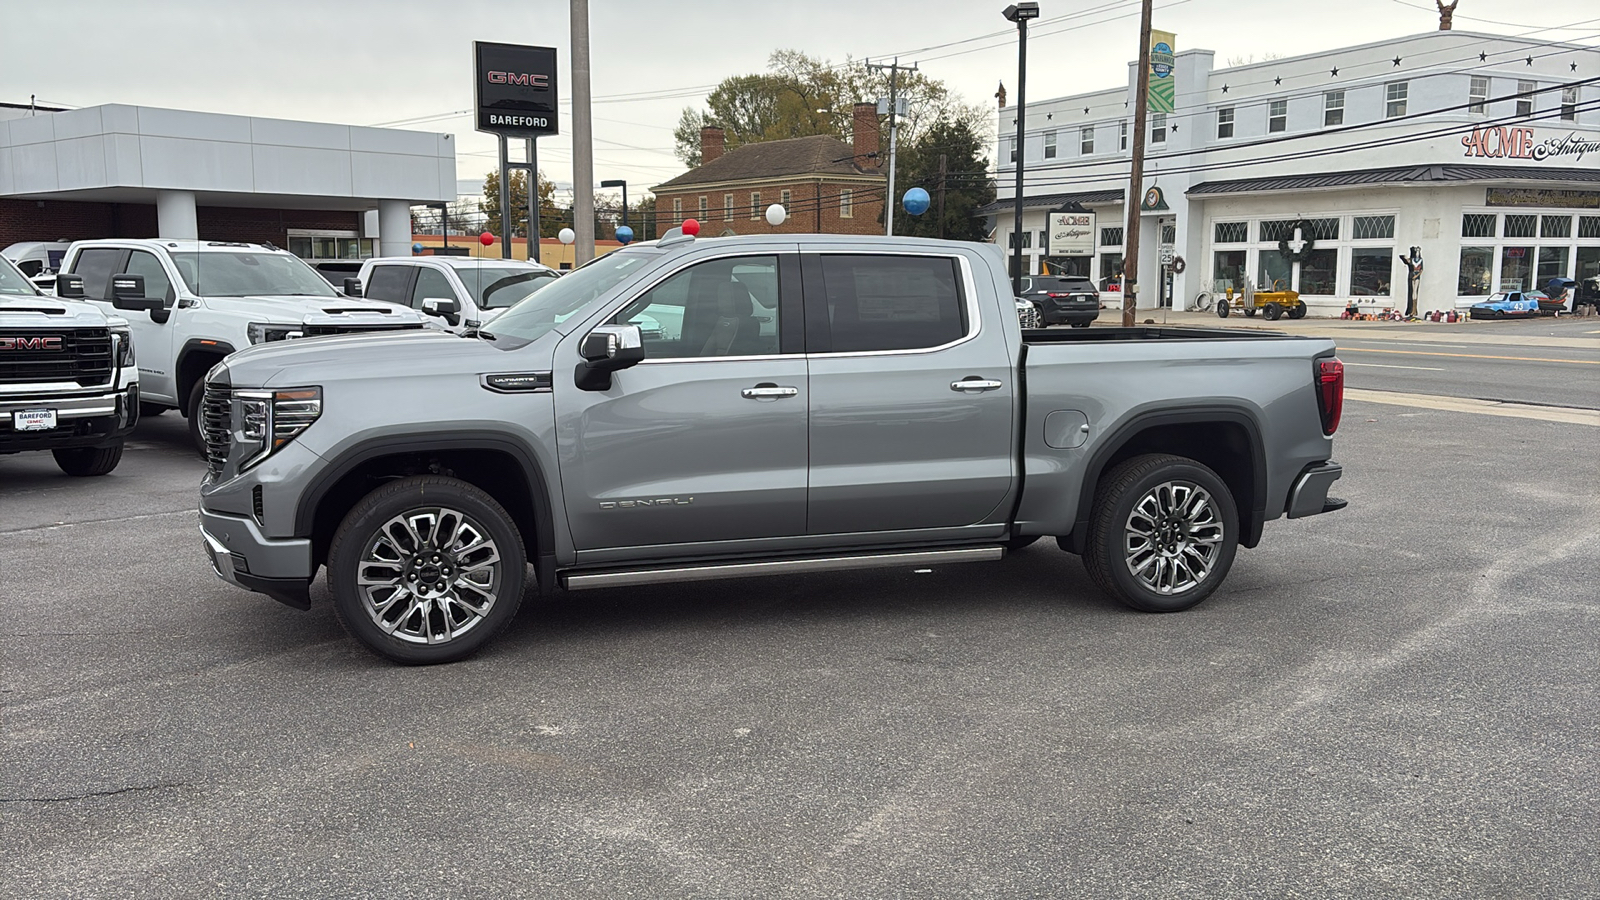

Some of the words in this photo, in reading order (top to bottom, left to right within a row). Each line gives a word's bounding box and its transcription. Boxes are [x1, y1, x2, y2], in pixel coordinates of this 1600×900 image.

[487, 70, 549, 87] GMC
[489, 114, 548, 128] BAREFORD
[1461, 126, 1535, 159] ACME
[1161, 254, 1172, 263] 25
[1513, 303, 1524, 311] 43
[19, 412, 52, 420] BAREFORD
[599, 496, 694, 509] DENALI
